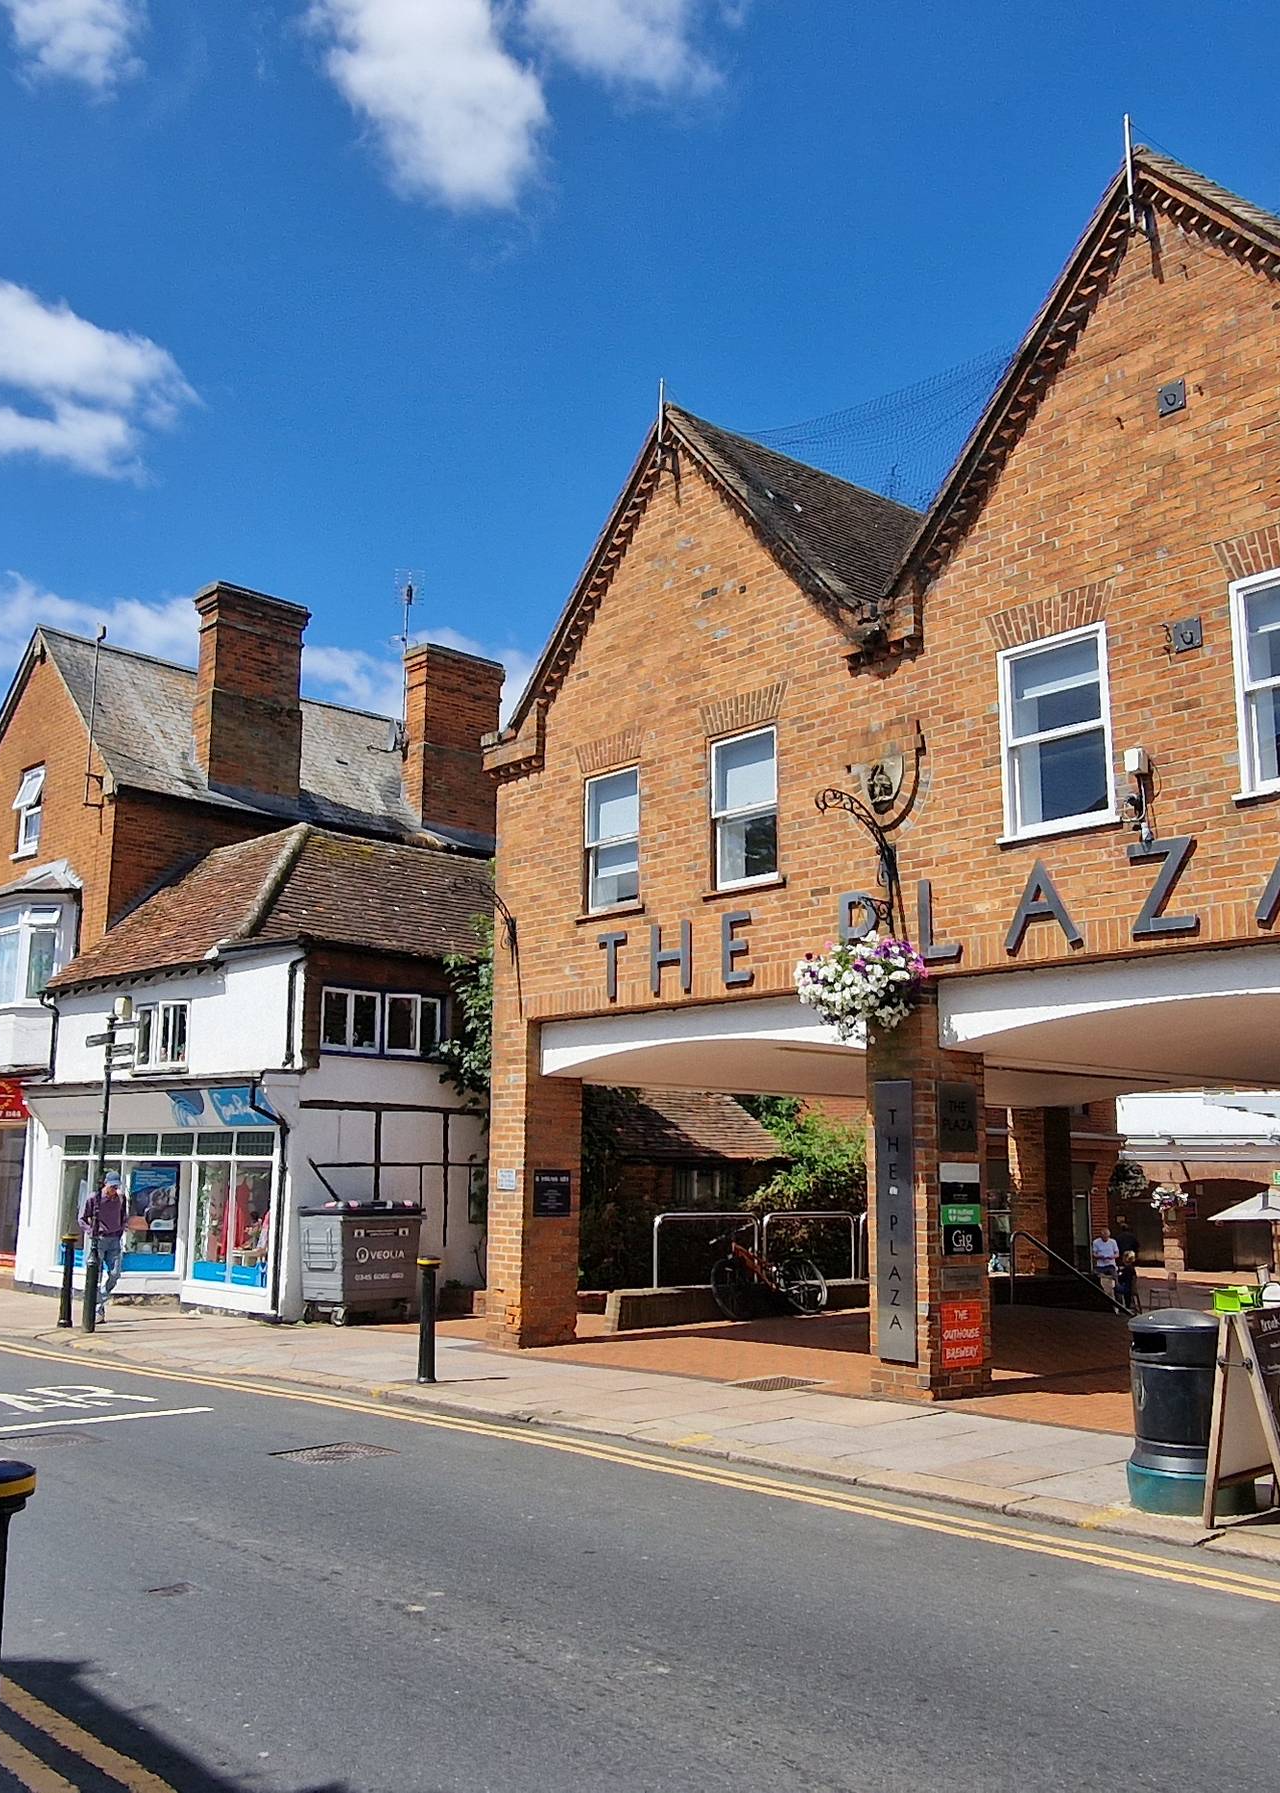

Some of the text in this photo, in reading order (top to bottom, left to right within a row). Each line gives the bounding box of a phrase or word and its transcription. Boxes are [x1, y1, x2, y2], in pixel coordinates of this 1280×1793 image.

[596, 910, 754, 1000] THE
[887, 1108, 899, 1181] THE
[952, 1229, 973, 1252] Gig
[370, 1250, 405, 1260] VEOLIA
[888, 1214, 903, 1331] PLAZA
[953, 1309, 969, 1321] THE
[942, 1327, 981, 1341] OUTHOUSE
[944, 1344, 979, 1361] BREWERY
